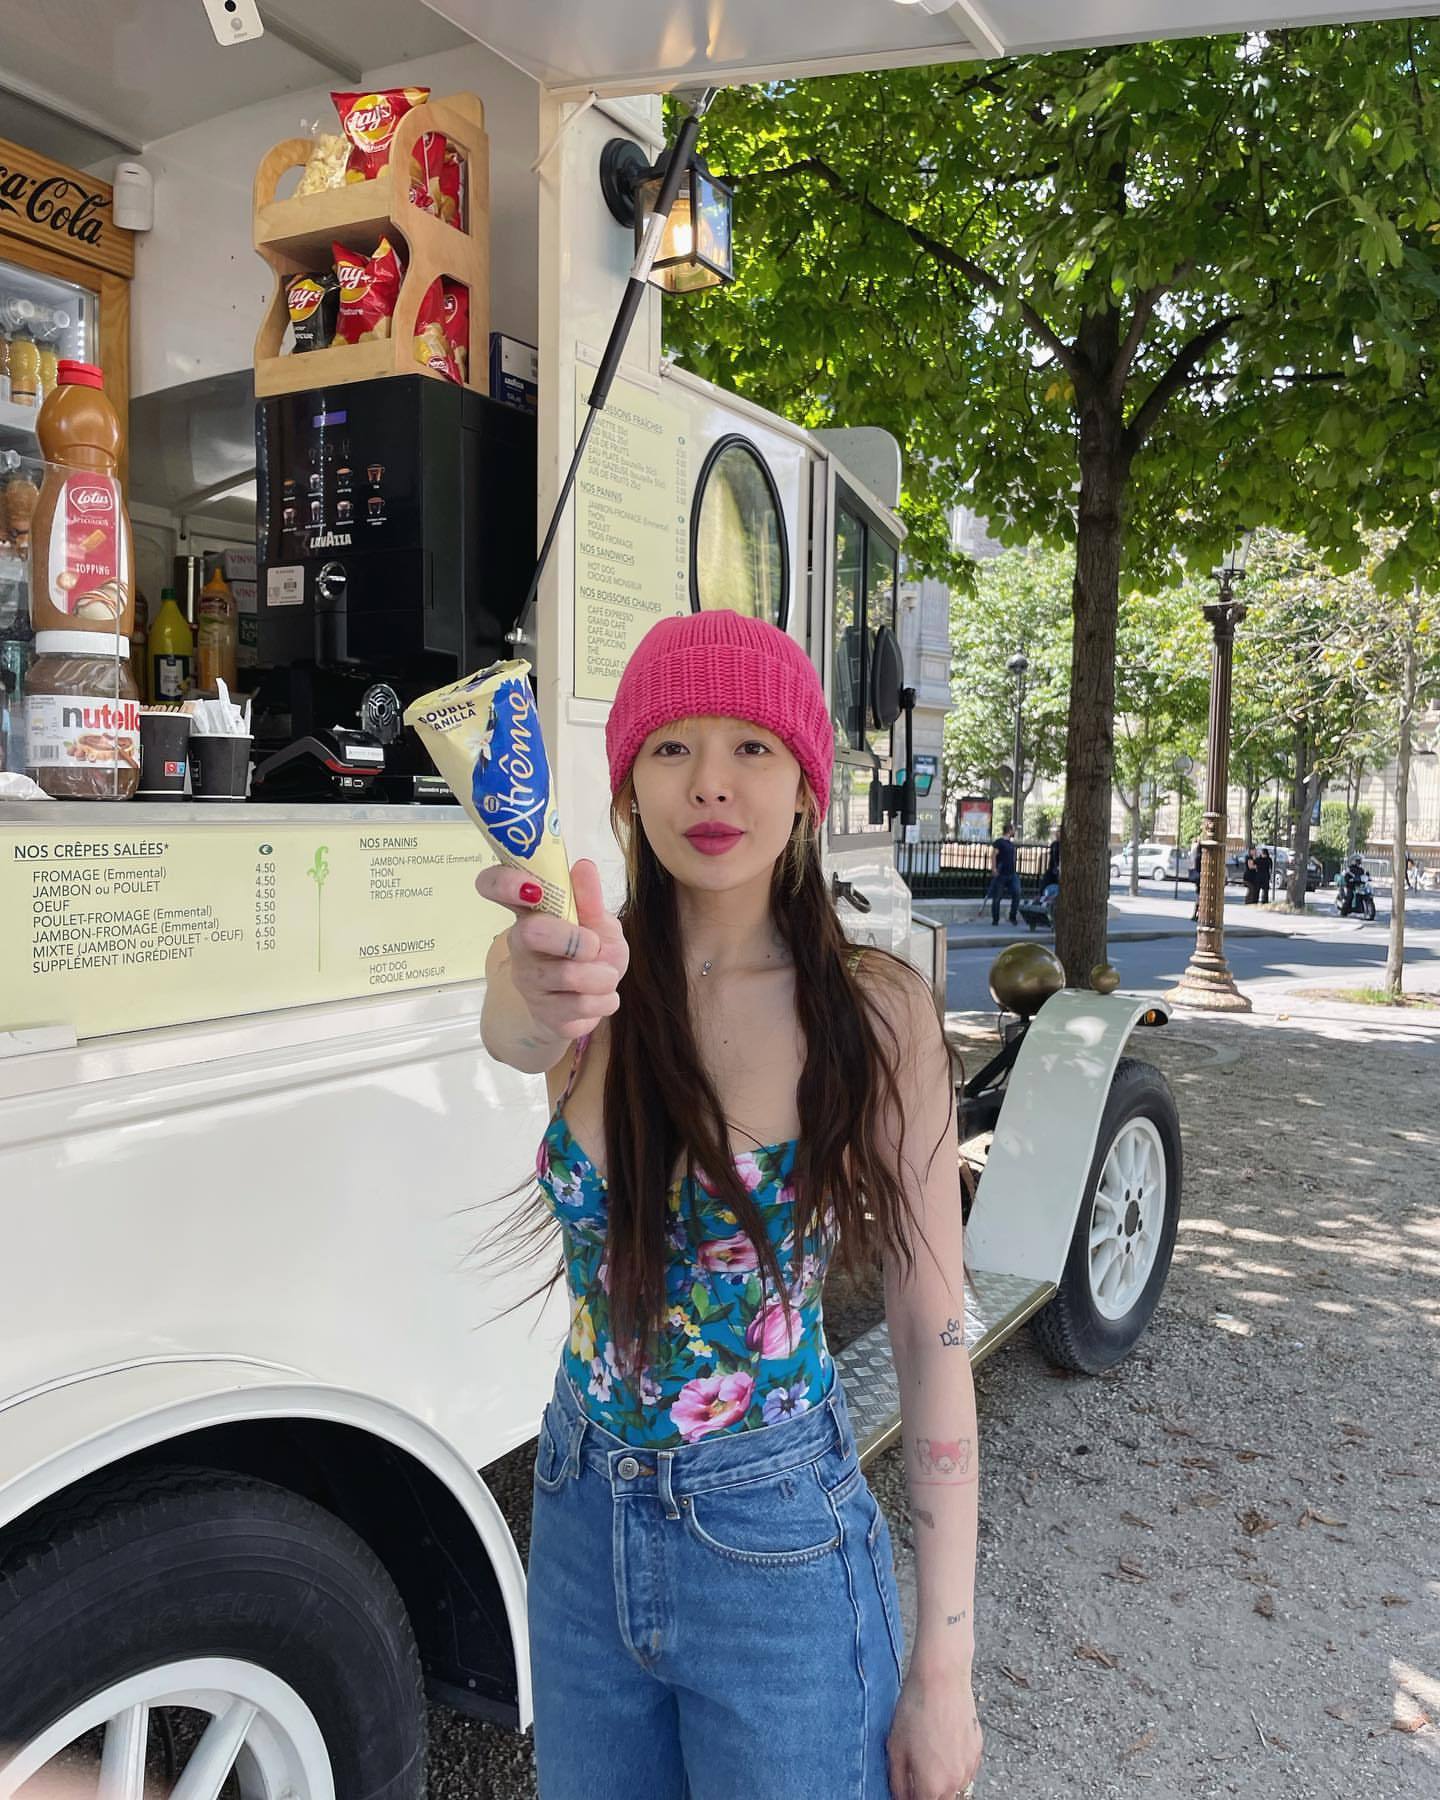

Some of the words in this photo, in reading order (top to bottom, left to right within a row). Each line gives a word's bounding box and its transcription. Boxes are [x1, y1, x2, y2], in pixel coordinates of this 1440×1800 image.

[77, 490, 109, 505] Lotus
[580, 480, 595, 495] NOS
[597, 485, 623, 503] PANINIS
[588, 520, 610, 532] POULET
[310, 531, 352, 548] LAVAZZA
[580, 543, 595, 554] NOS
[75, 563, 110, 576] TOPPING
[588, 561, 600, 571] HOT
[601, 564, 616, 575] DOG
[580, 585, 595, 598] NOS
[597, 589, 631, 606] BOISSONS
[631, 597, 662, 612] CHAUDES
[587, 656, 621, 668] CHOCOLAT
[433, 709, 477, 731] ANILLA
[359, 838, 380, 849] NOS
[382, 837, 418, 848] PANINIS
[14, 845, 49, 858] NOS
[54, 842, 109, 858] CRÊPES
[370, 855, 445, 867] JAMBON-FROMAGE
[446, 854, 483, 864] (Emmental)
[255, 862, 276, 873] 4.50
[370, 868, 394, 877] THON
[33, 869, 100, 883] FROMAGE
[103, 866, 167, 881] (Emmental)
[255, 875, 276, 886] 4.50
[32, 884, 91, 898] JAMBON
[95, 886, 110, 895] ou
[113, 881, 161, 894] POULET
[370, 878, 401, 889] POULET
[255, 888, 276, 899] 4.50
[370, 889, 393, 900] TROIS
[394, 887, 433, 898] FROMAGE
[33, 900, 71, 913] OEUF
[255, 901, 276, 912] 5.50
[33, 909, 150, 928] POULET-FROMAGE
[153, 905, 212, 921] (Emmental)
[255, 914, 276, 925] 5.50
[32, 923, 158, 943] JAMBON-FROMAGE
[160, 918, 219, 935] (Emmental)
[255, 927, 276, 938] 6.50
[33, 943, 74, 958] MIXTE
[78, 939, 136, 956] (JAMBON
[140, 939, 154, 949] ou
[157, 933, 201, 947] POULET
[211, 929, 244, 942] OEUF)
[256, 939, 276, 951] 1.50
[359, 945, 380, 957] NOS
[382, 939, 436, 954] SANDWICHS
[33, 954, 118, 973] SUPPLÉMENT
[122, 947, 194, 965] INGRÉDIENT
[369, 962, 387, 974] HOT
[388, 960, 408, 972] DOG
[369, 971, 402, 985] CROQUE
[405, 966, 446, 980] MONSIEUR
